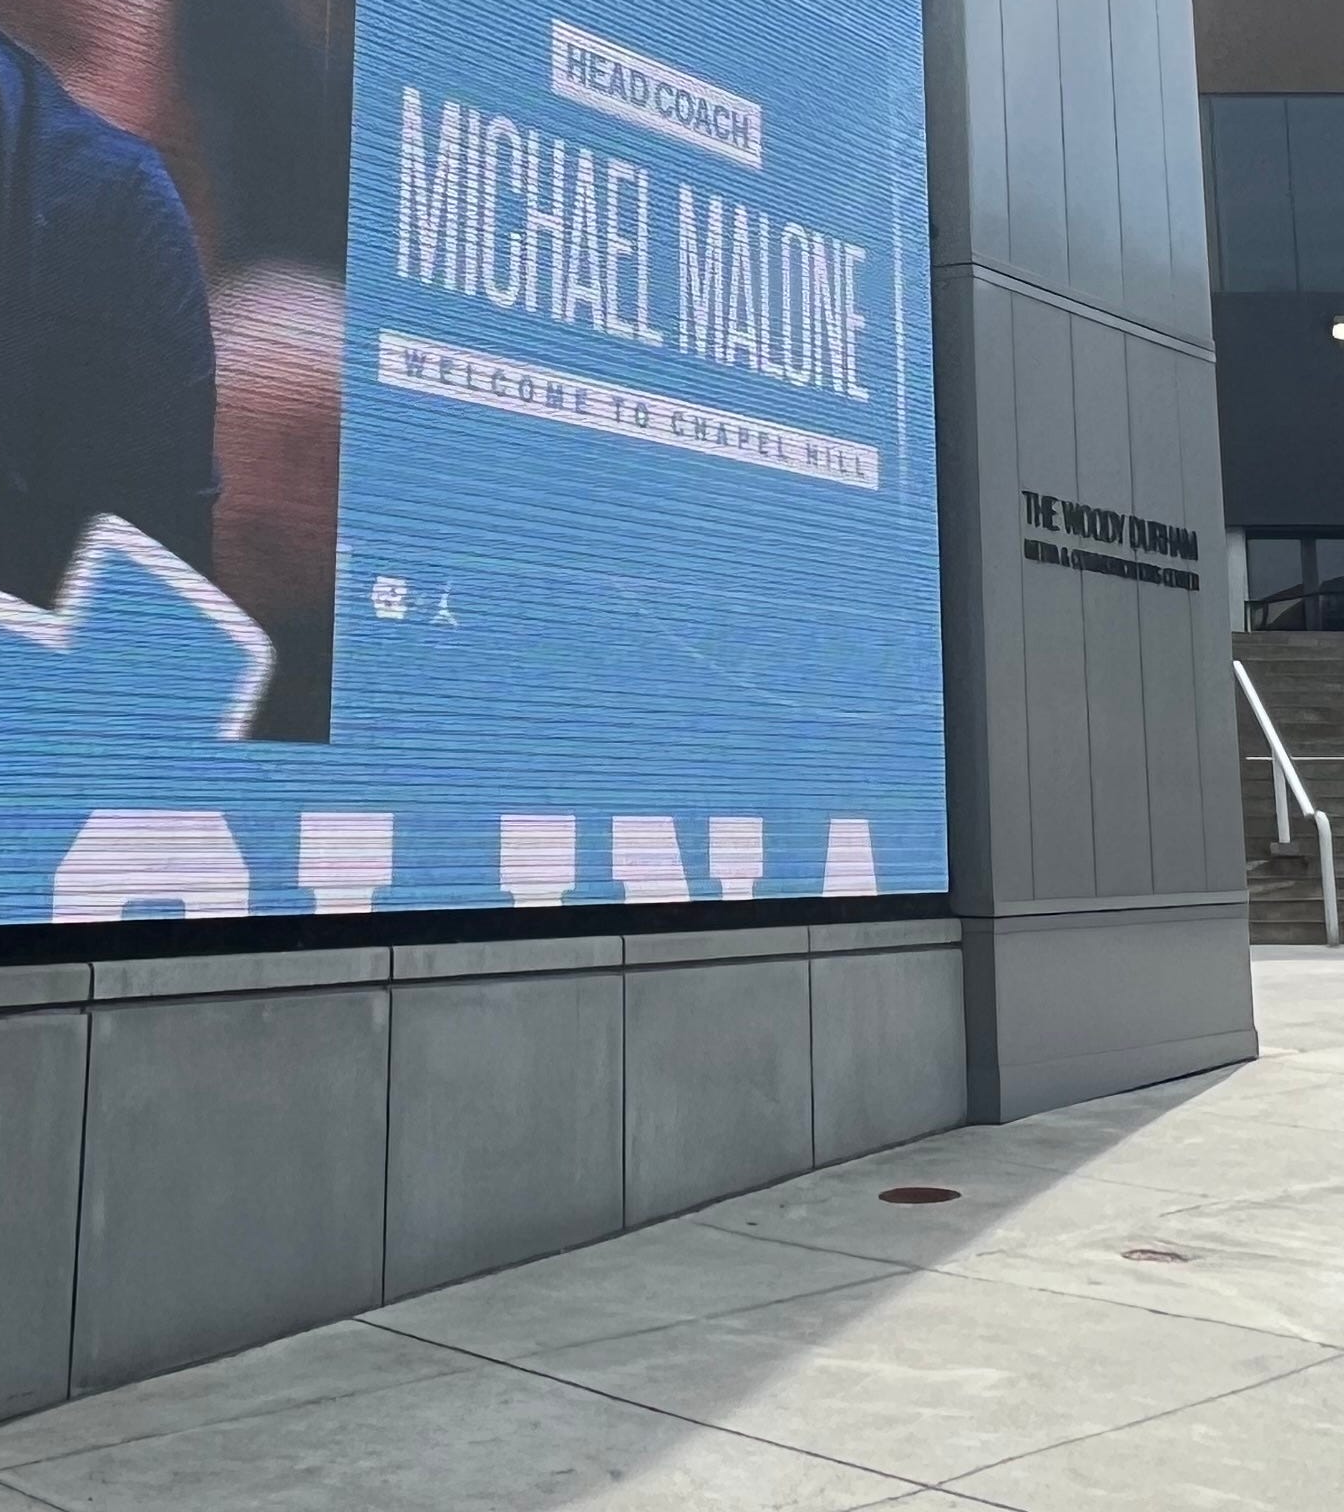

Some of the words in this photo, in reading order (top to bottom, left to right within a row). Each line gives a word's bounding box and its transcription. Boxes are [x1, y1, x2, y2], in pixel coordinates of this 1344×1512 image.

[567, 42, 649, 107] HEAD
[656, 81, 749, 149] COACH
[397, 85, 663, 347] MICHAEL
[678, 182, 870, 402] MALONE
[406, 348, 588, 415] WELCOME
[612, 395, 649, 429] TO
[671, 410, 787, 459] CHAPEL
[807, 442, 865, 476] HILL
[1022, 490, 1060, 532] THE
[1061, 500, 1125, 544] WOODY
[1129, 514, 1199, 562] DURHAM
